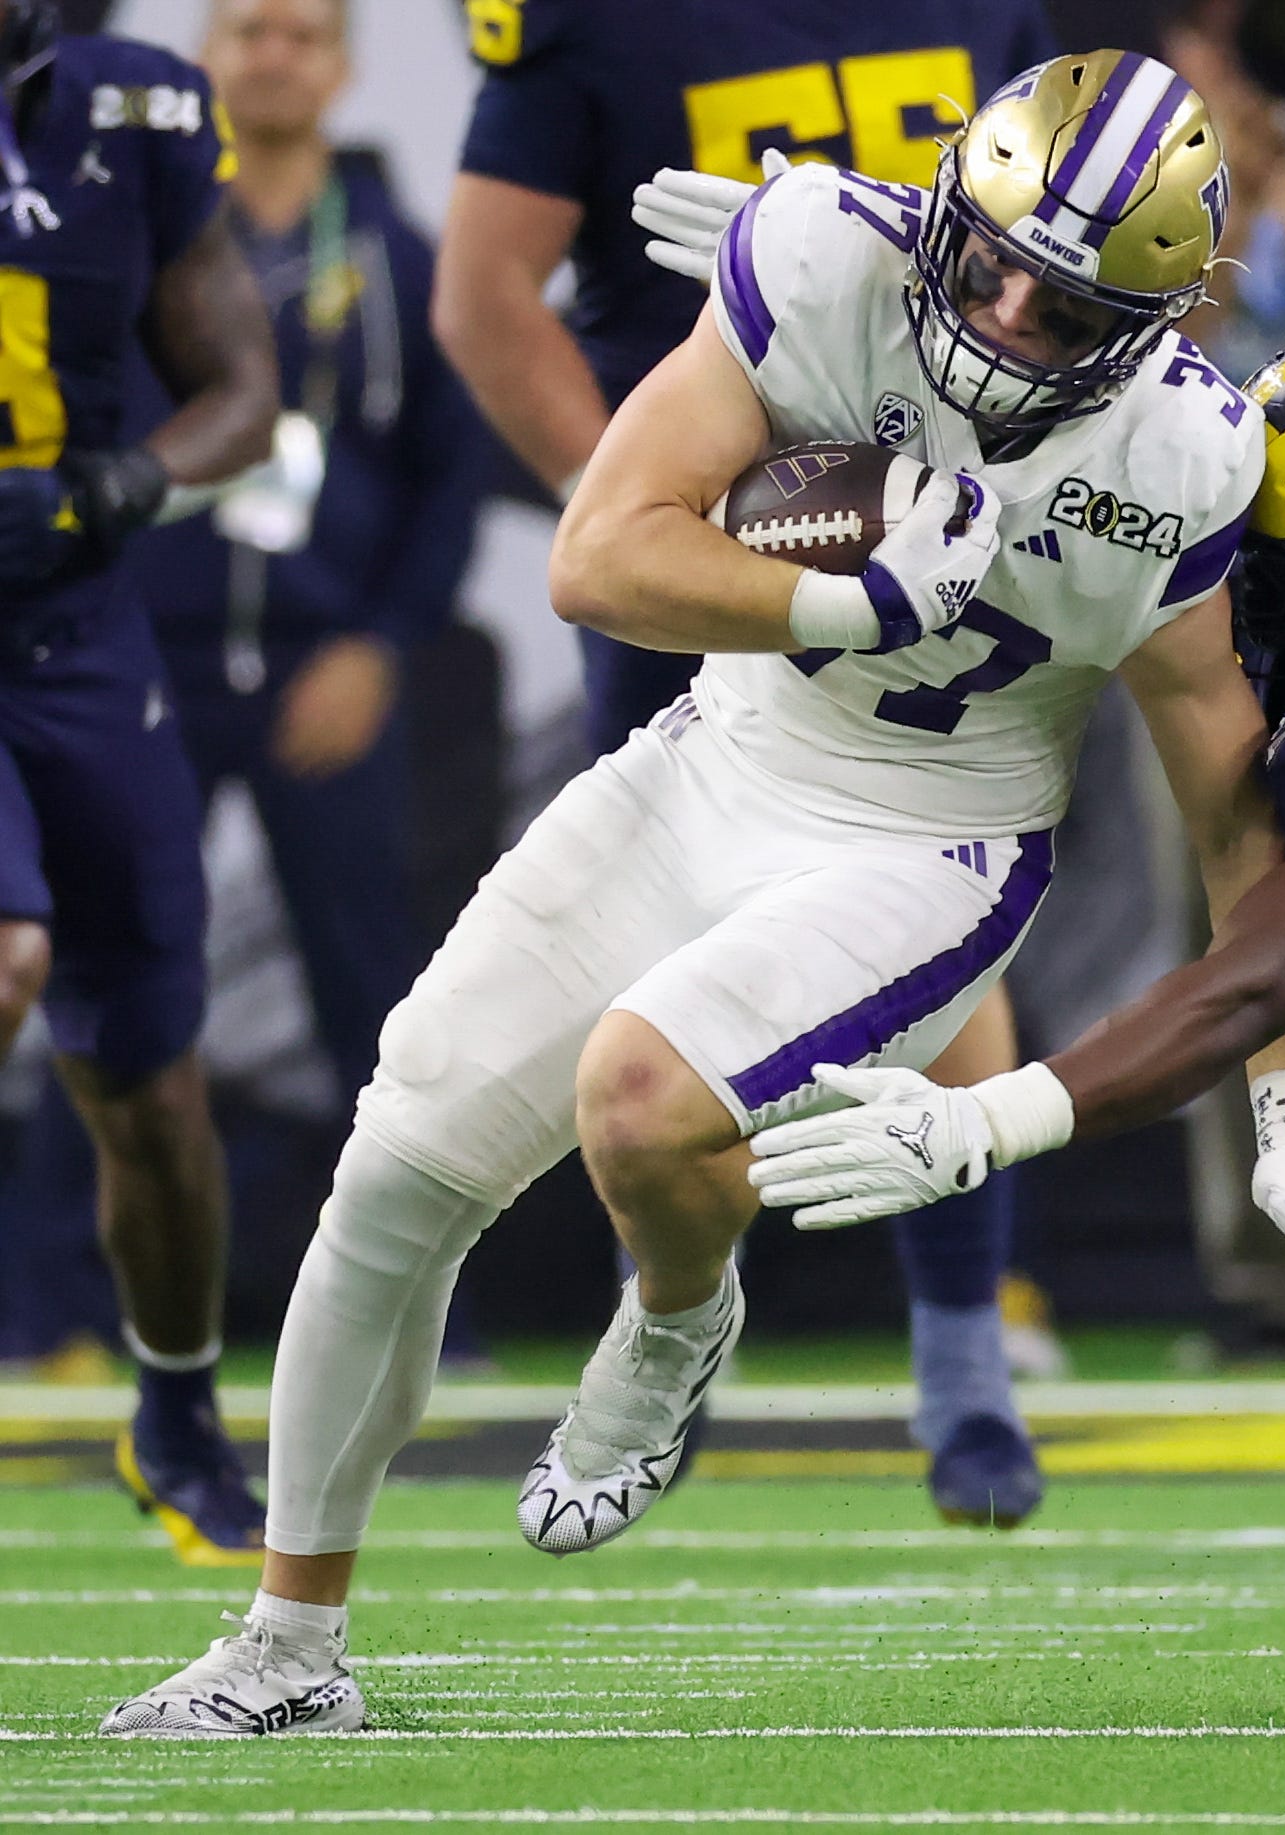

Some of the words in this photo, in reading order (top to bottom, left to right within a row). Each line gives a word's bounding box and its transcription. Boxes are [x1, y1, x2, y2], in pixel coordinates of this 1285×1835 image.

[875, 393, 924, 438] PAC
[875, 416, 904, 443] 12
[1047, 477, 1184, 560] 2024
